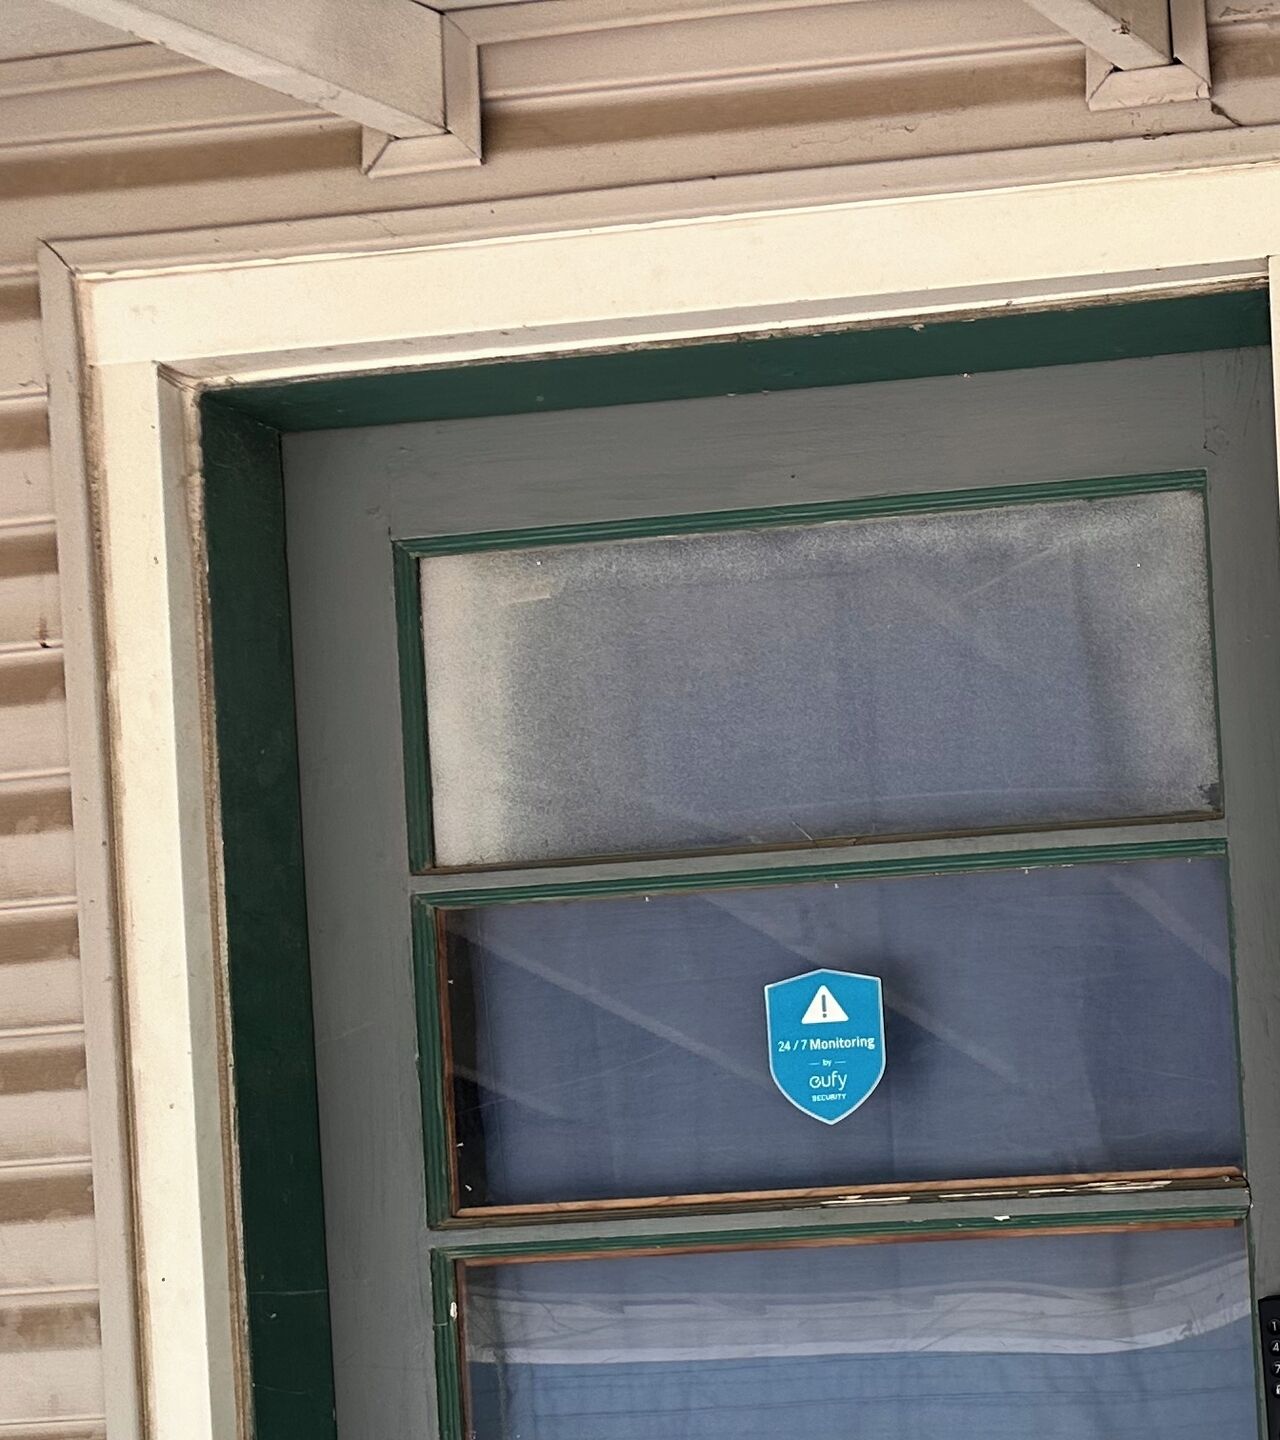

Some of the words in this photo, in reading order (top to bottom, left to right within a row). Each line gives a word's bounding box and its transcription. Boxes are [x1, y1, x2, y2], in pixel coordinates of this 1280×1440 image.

[809, 1036, 876, 1051] Monitoring
[822, 1059, 832, 1067] by
[809, 1070, 848, 1091] eufy
[1271, 1321, 1277, 1331] 1
[1272, 1342, 1280, 1352] 4
